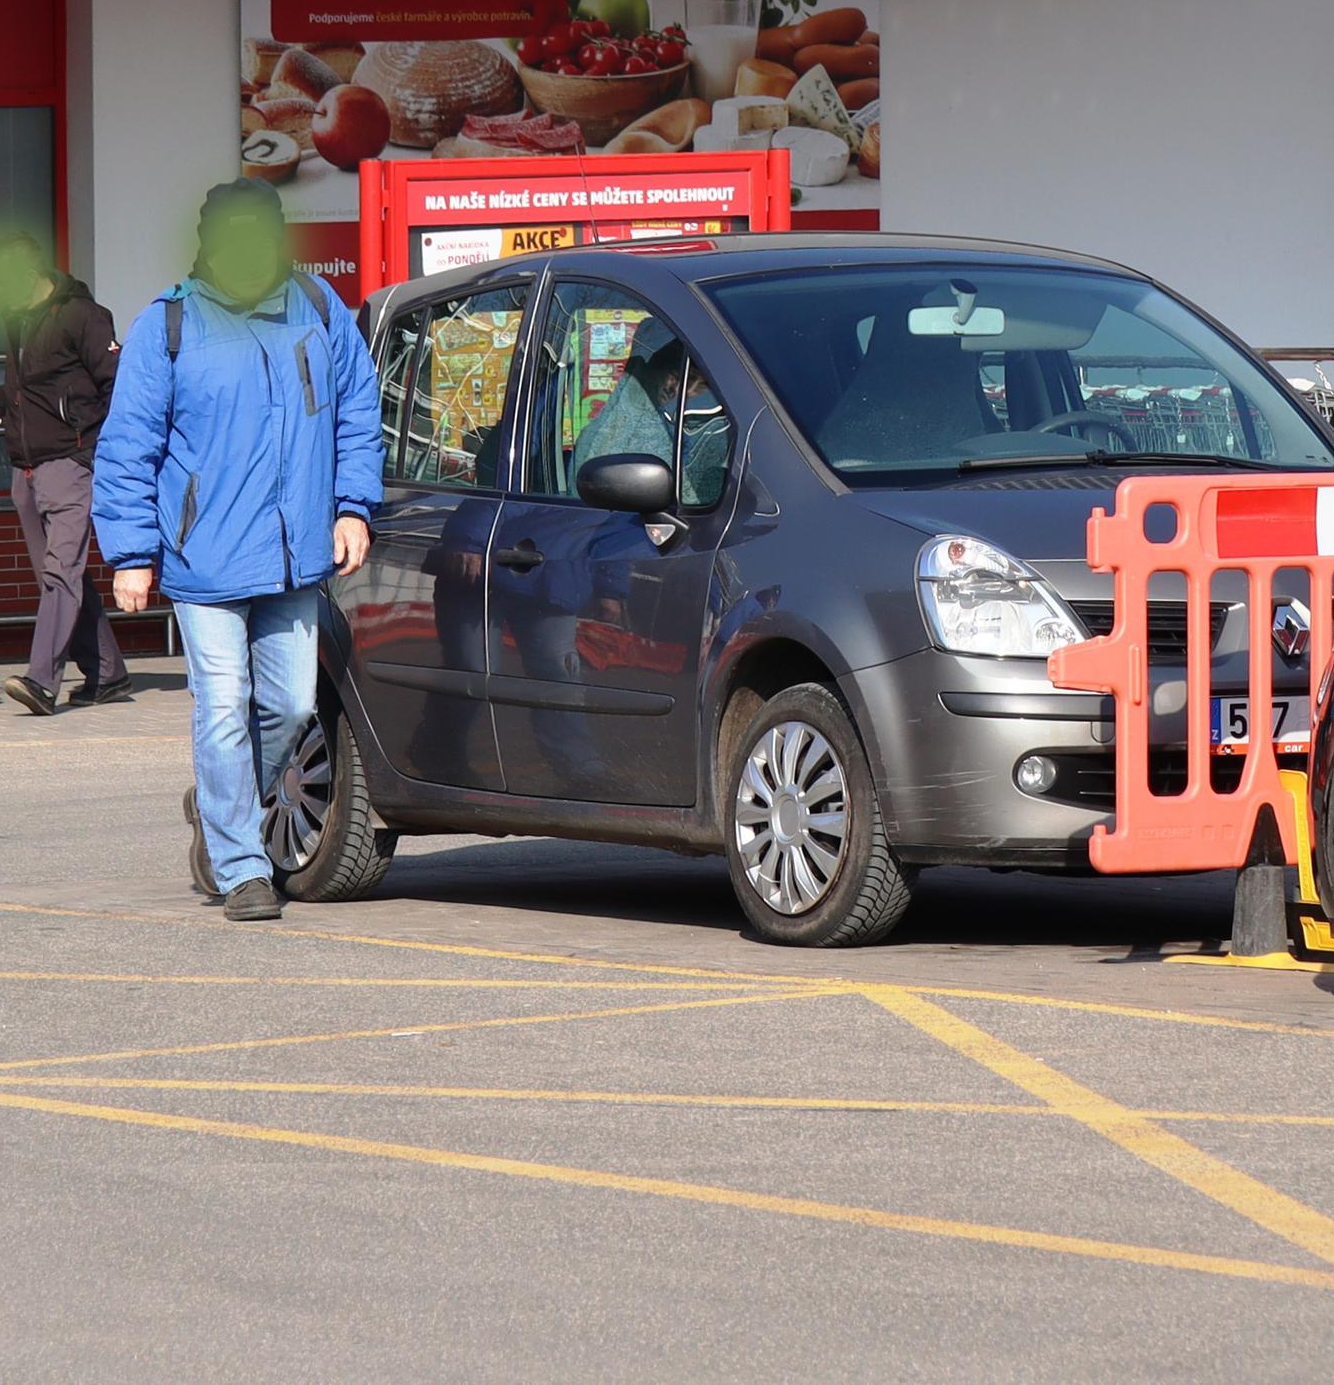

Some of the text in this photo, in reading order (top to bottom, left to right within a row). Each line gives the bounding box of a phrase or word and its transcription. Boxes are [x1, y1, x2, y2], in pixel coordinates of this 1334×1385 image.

[309, 13, 374, 25] Podporujeme
[452, 11, 488, 23] výrobce
[425, 186, 735, 210] NA NAŠE NÍZKÉ CENY SE MŮŽETE SPOLEHNOUT
[512, 229, 561, 251] AKCE
